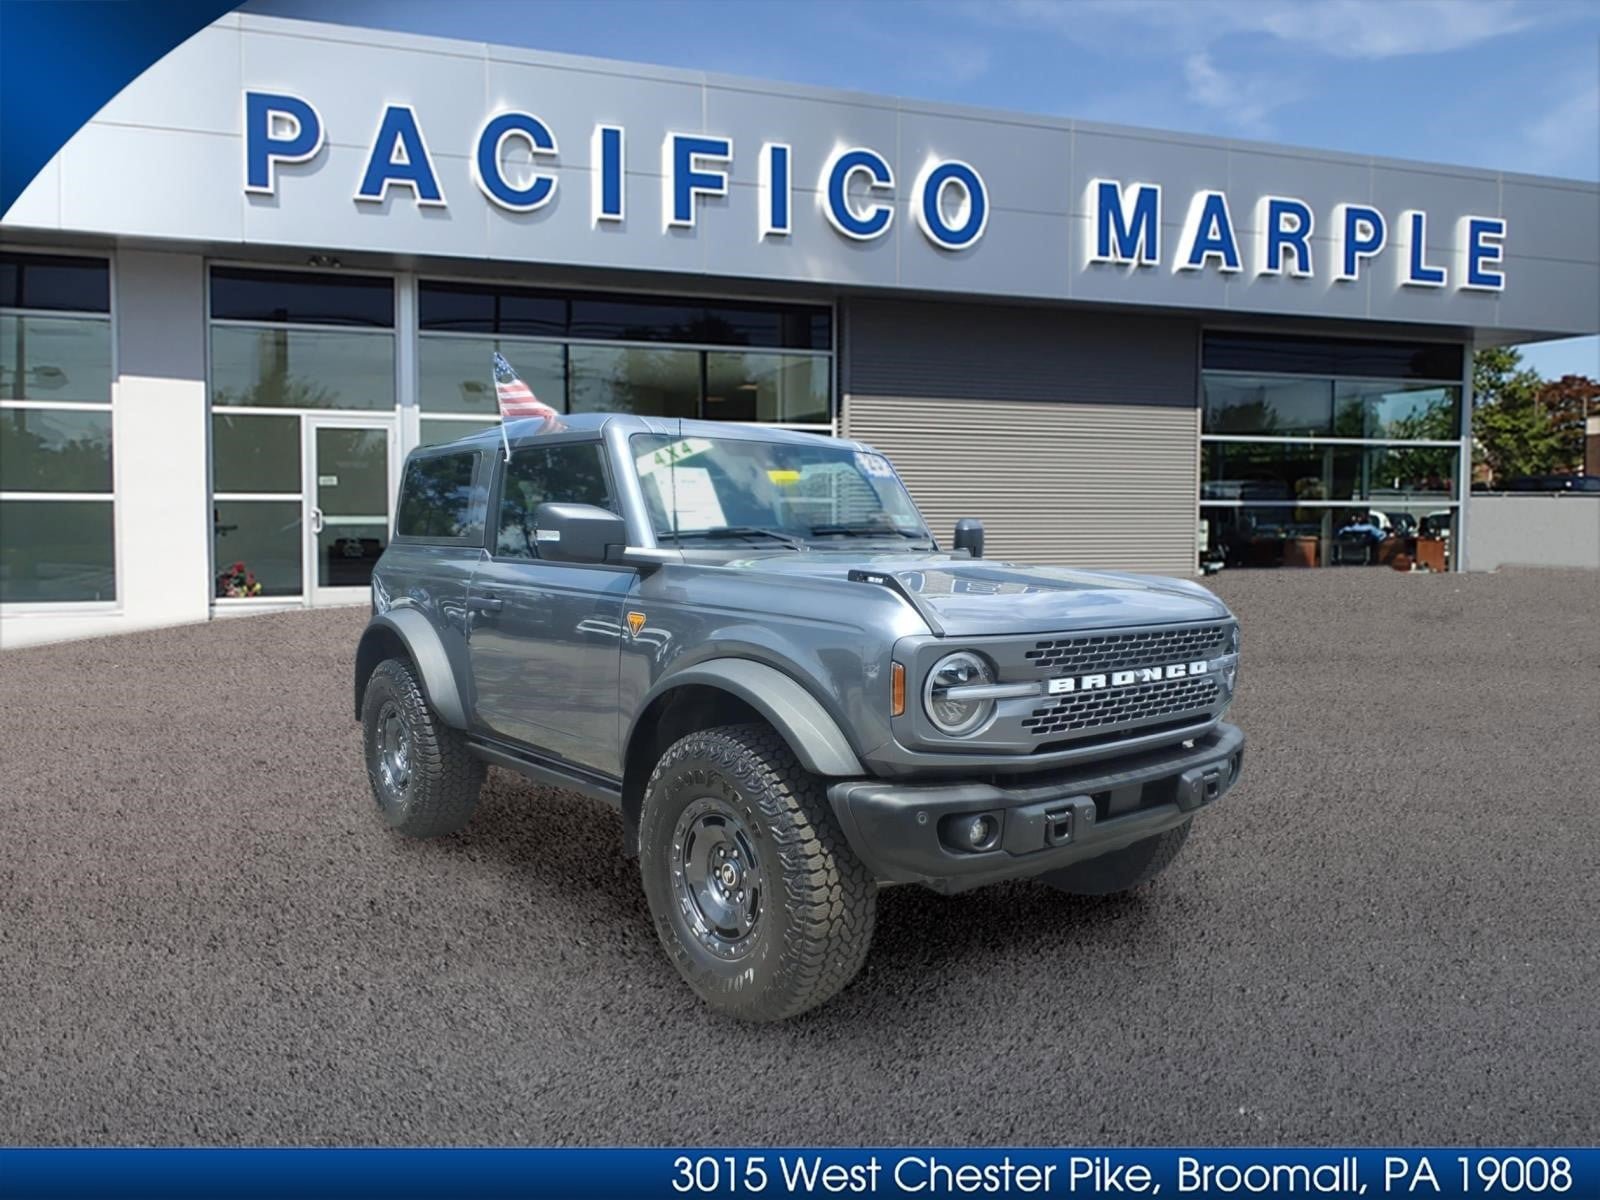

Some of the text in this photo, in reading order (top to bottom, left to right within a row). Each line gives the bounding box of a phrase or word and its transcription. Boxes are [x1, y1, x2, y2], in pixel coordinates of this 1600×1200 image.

[243, 89, 1507, 293] PACIFICO MARPLE
[1048, 660, 1208, 694] BRONCO
